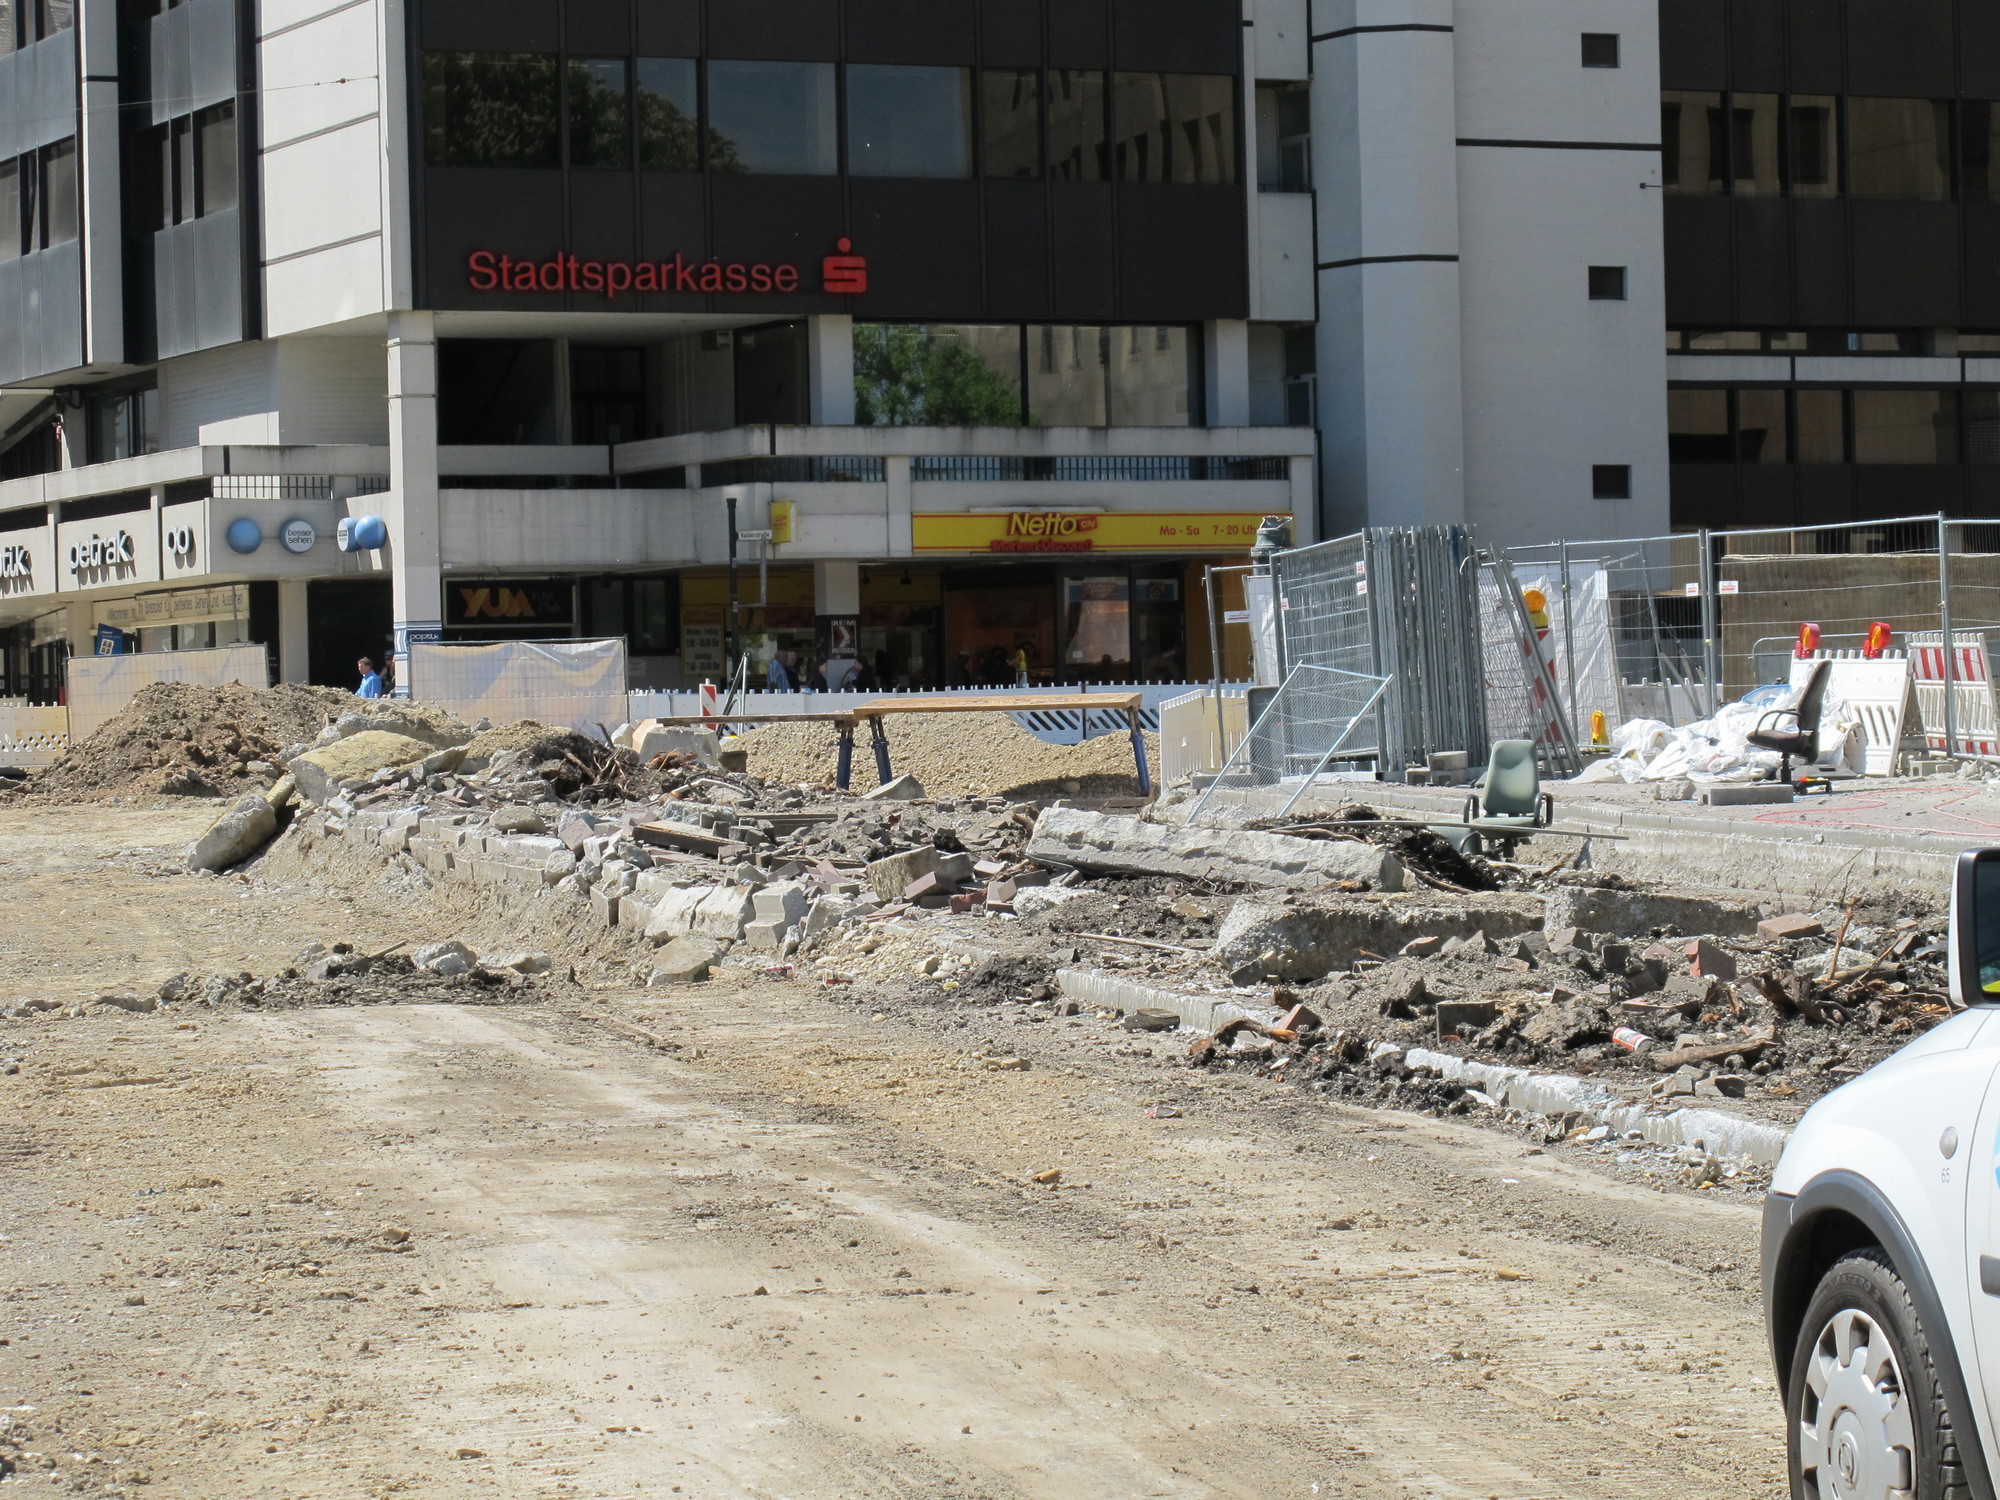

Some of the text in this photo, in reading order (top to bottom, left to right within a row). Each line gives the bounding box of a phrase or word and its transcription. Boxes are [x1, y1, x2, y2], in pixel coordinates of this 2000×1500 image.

[468, 250, 798, 298] Stadtsparkasse
[287, 528, 312, 536] besser
[1008, 512, 1078, 536] Netto
[1160, 525, 1176, 535] Mo
[1186, 525, 1200, 535] Sa
[287, 536, 312, 544] sehen
[460, 588, 536, 617] YUM
[1941, 1167, 1951, 1184] 65
